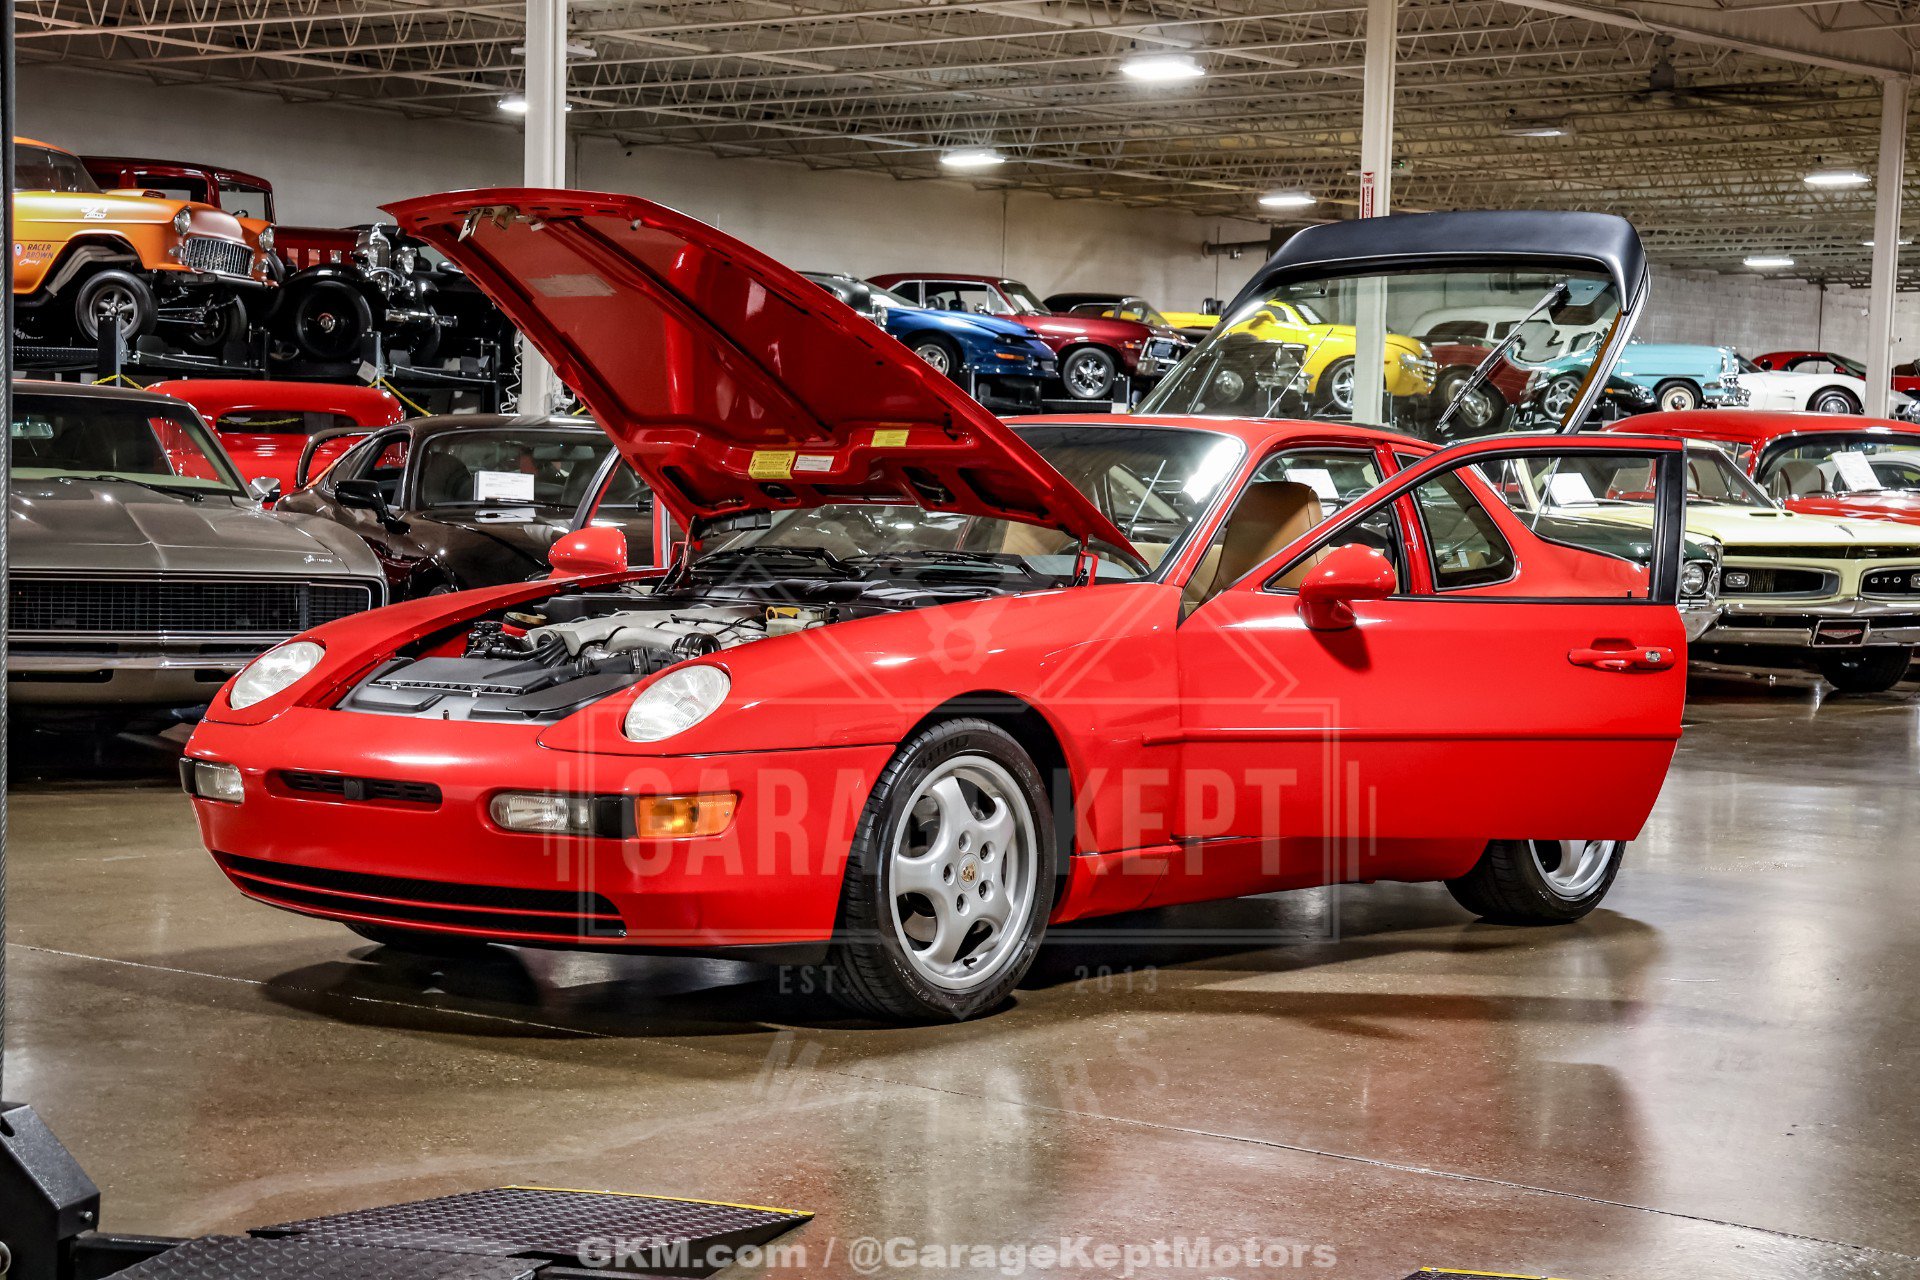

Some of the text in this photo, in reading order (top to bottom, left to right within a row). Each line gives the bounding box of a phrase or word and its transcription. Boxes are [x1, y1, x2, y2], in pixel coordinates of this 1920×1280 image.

[27, 243, 51, 251] RACER
[26, 251, 54, 259] BROWN
[1870, 576, 1901, 584] GTO
